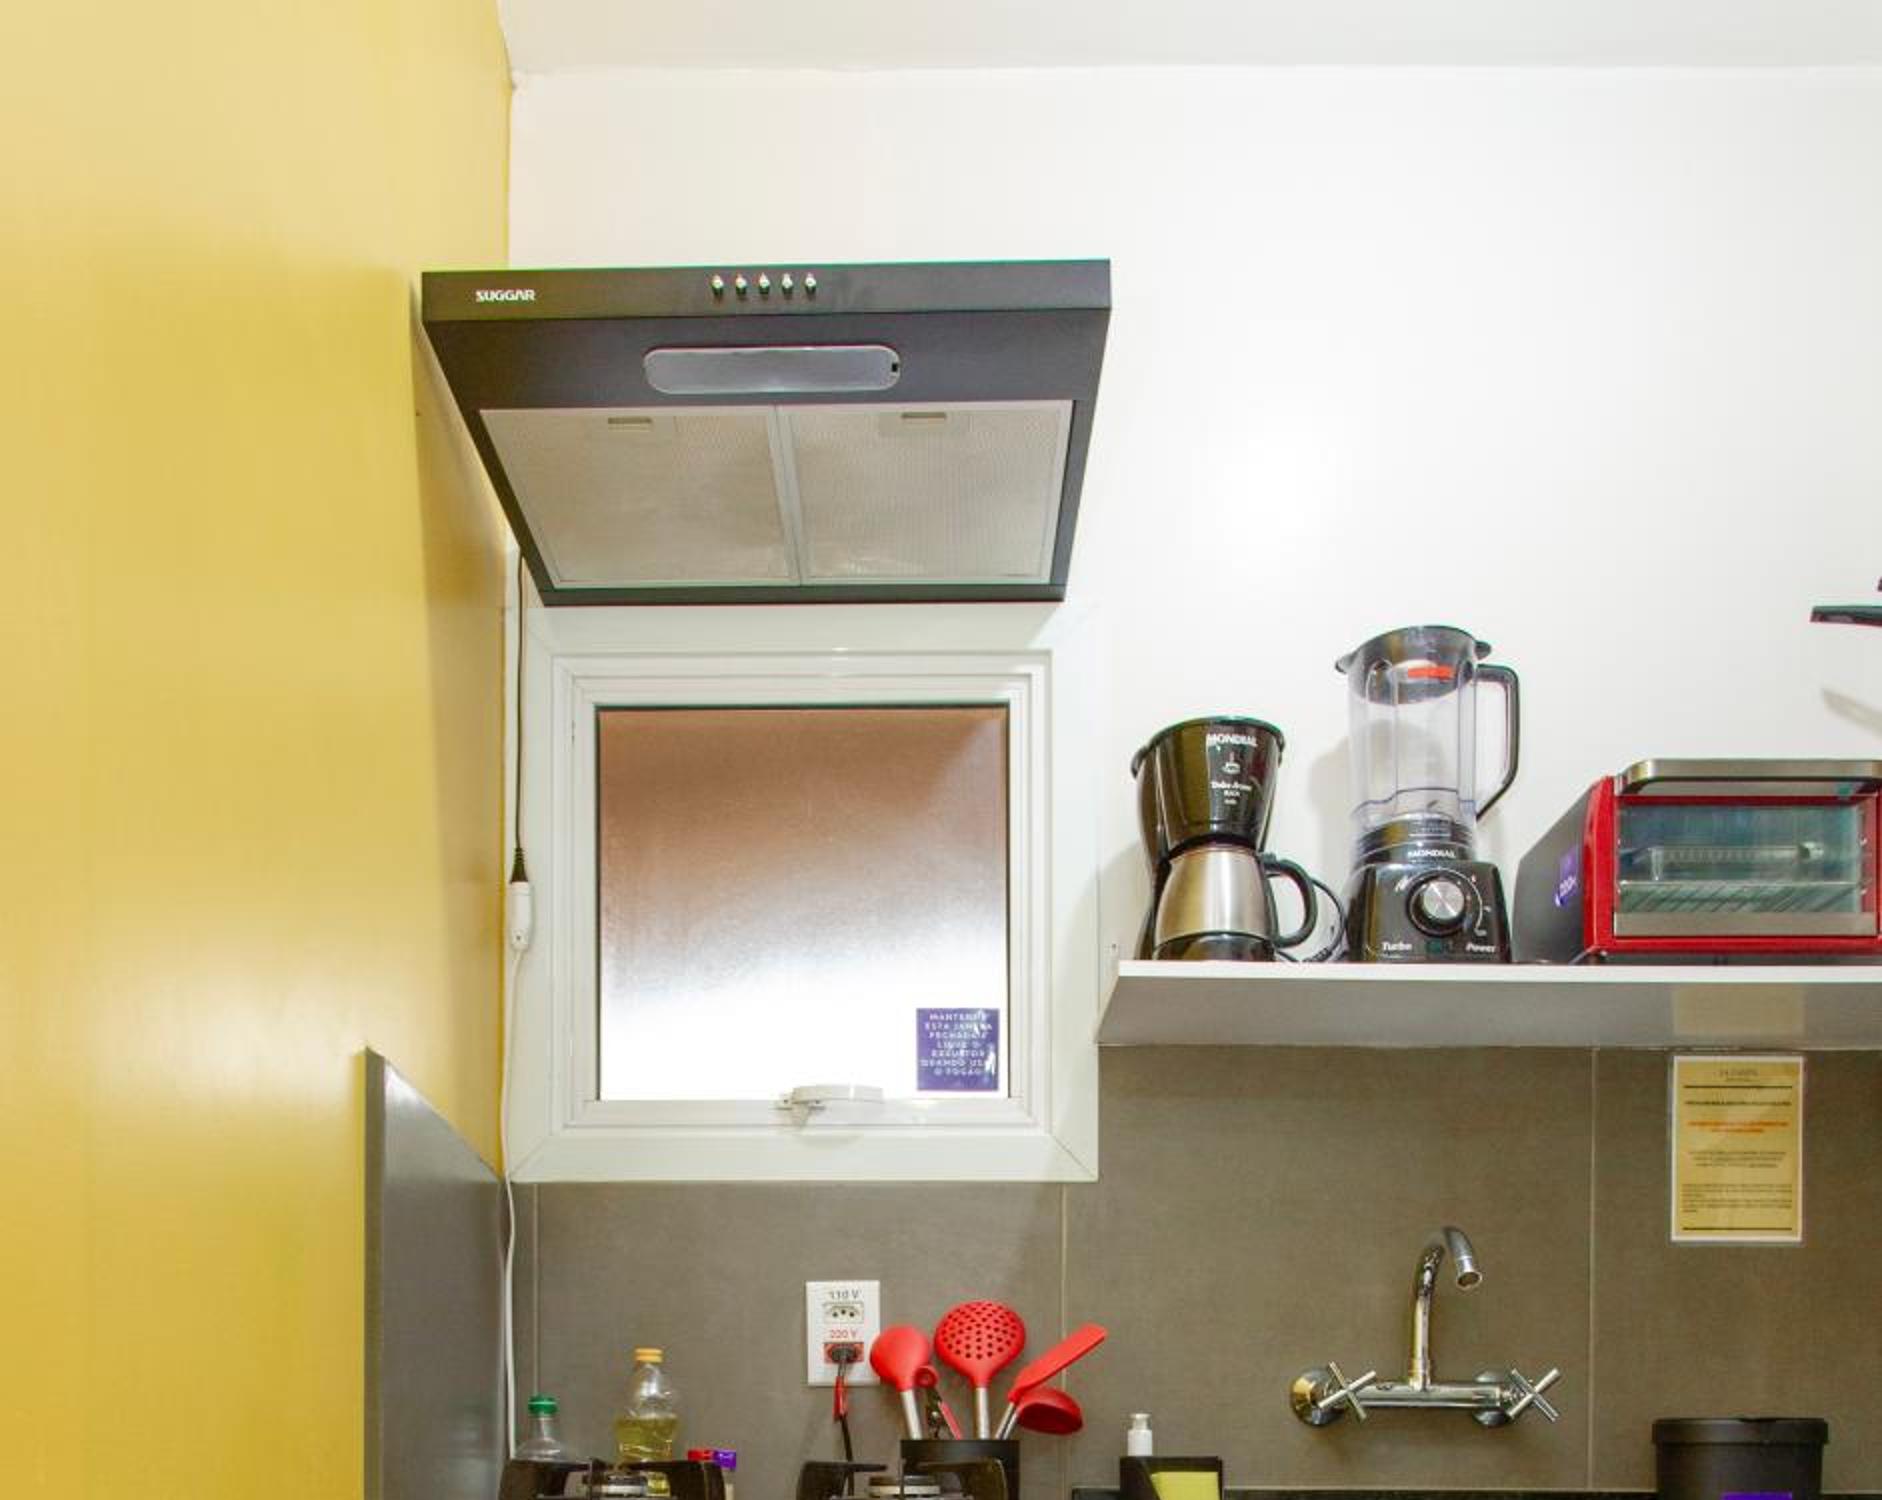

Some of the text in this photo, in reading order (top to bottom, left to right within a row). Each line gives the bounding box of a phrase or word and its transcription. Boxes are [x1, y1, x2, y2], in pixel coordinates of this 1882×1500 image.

[476, 289, 536, 302] SUGGAR
[1408, 850, 1456, 858] MONDIAL
[1382, 941, 1412, 951] Turbo
[1466, 942, 1496, 953] Power
[829, 1329, 858, 1339] 220 V
